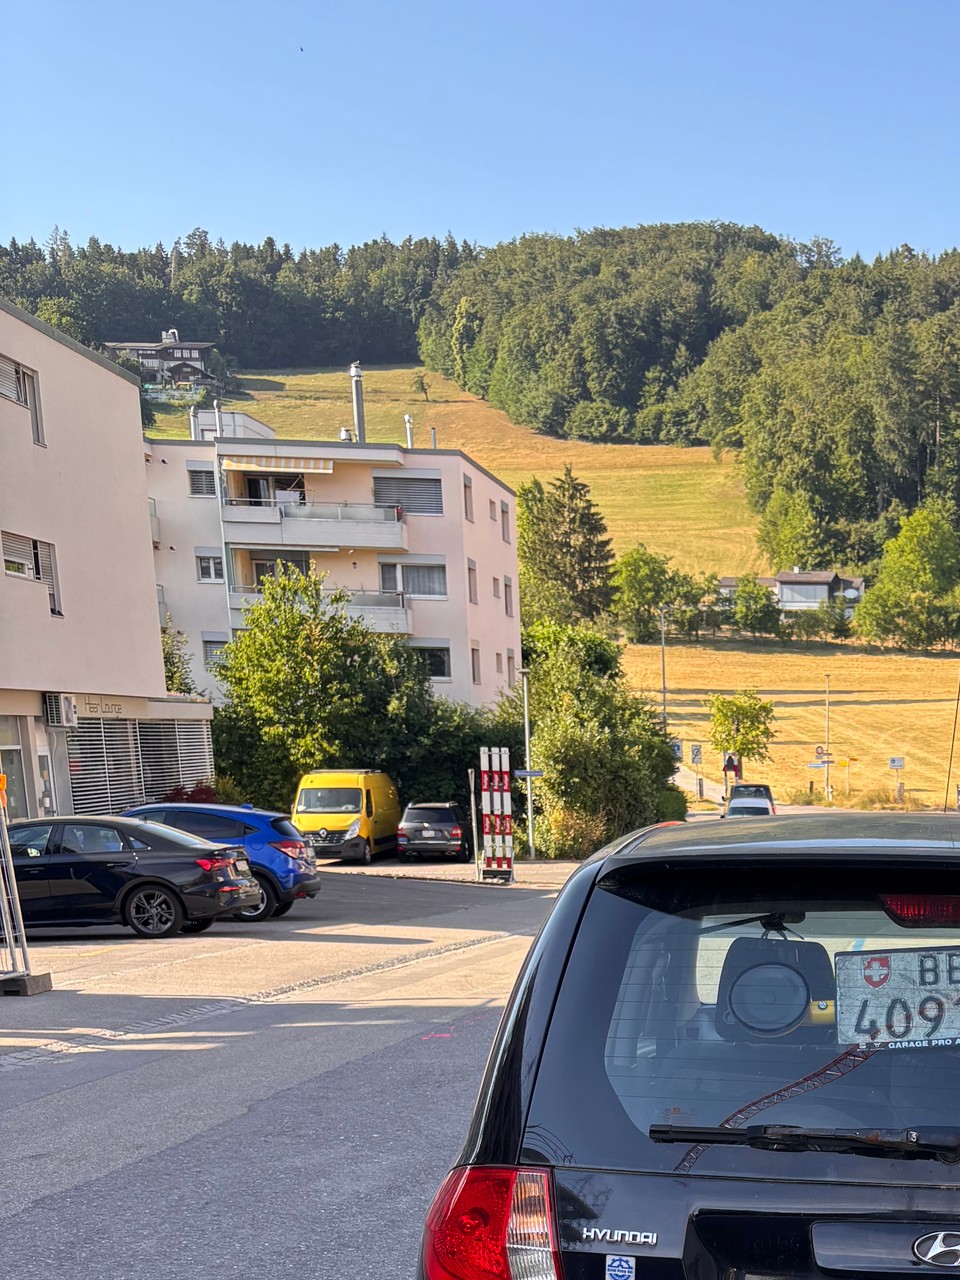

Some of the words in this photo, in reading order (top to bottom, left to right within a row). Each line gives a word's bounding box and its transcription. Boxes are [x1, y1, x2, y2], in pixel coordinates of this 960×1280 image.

[888, 1039, 929, 1049] GARAGE
[931, 1038, 952, 1047] PRO
[582, 1227, 658, 1246] HYUNDAI
